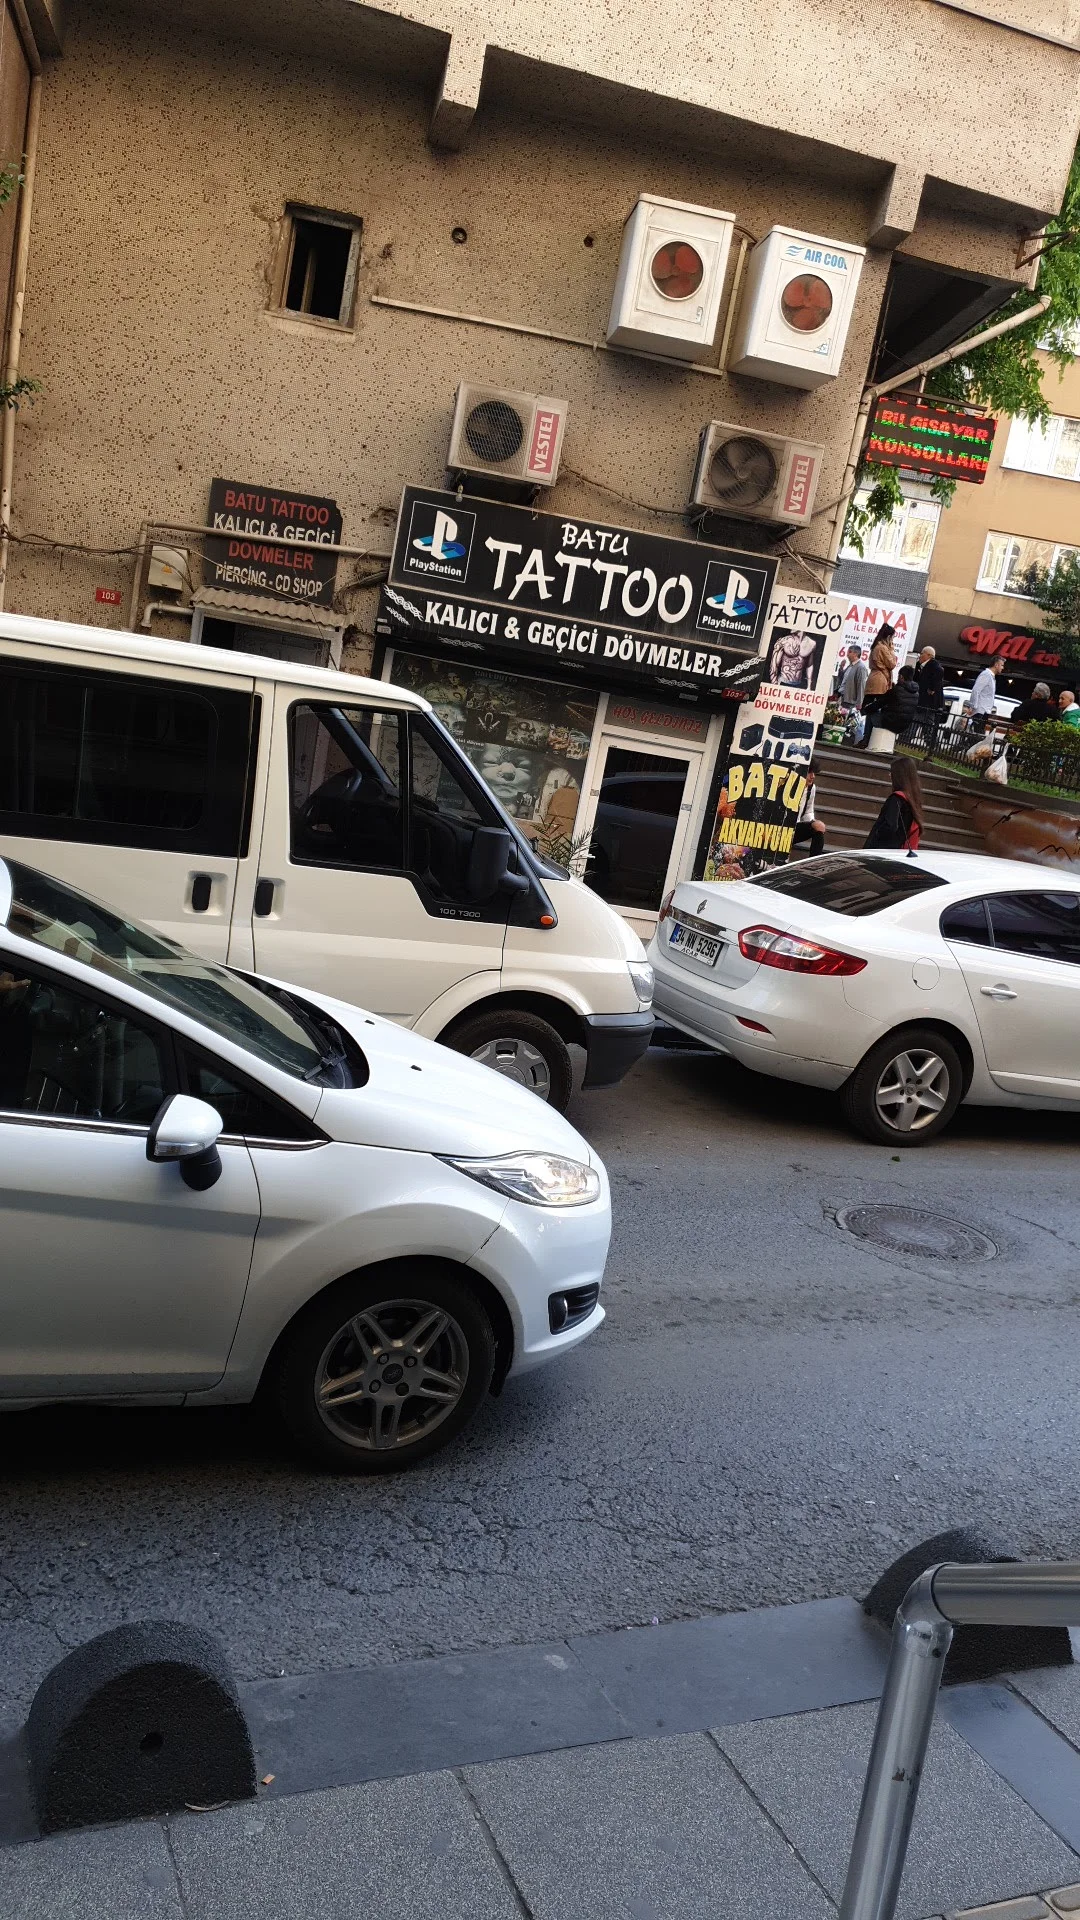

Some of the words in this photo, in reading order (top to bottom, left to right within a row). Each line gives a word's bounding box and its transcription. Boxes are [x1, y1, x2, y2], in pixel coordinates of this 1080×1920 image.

[804, 249, 822, 263] AIR
[533, 413, 556, 472] VESTEL
[786, 456, 812, 515] VESTEL
[224, 489, 266, 513] BATU
[271, 497, 329, 525] TATTOO
[213, 512, 265, 536] KALICI
[268, 522, 279, 538] &
[561, 523, 630, 556] BATU
[215, 560, 267, 588] PİERCİNG
[275, 574, 291, 592] CD
[292, 577, 323, 597] SHOP
[409, 557, 463, 578] PlayStation
[484, 536, 694, 625] TATTOO
[101, 591, 115, 601] 103
[787, 594, 827, 605] BATU
[701, 614, 752, 634] PlayStation
[768, 602, 842, 633] TATTOO
[845, 604, 907, 632] ANYA
[853, 622, 867, 633] İLE
[423, 600, 498, 636] KALICI
[504, 617, 521, 640] &
[527, 622, 599, 656] GEÇİCİ
[603, 632, 723, 678] DÖVMELER
[961, 625, 1035, 662] Will
[754, 698, 812, 717] DÖVMELER
[758, 686, 781, 698] ALICI
[783, 690, 791, 700] &
[793, 692, 825, 706] GEÇİCİ
[614, 704, 638, 725] HOŞ
[728, 762, 805, 812] BATU
[718, 817, 795, 853] AKVARYUM
[440, 908, 456, 916] 100
[458, 910, 481, 918] T300
[675, 928, 686, 945] 34
[685, 932, 698, 950] NN
[696, 937, 718, 959] 5296
